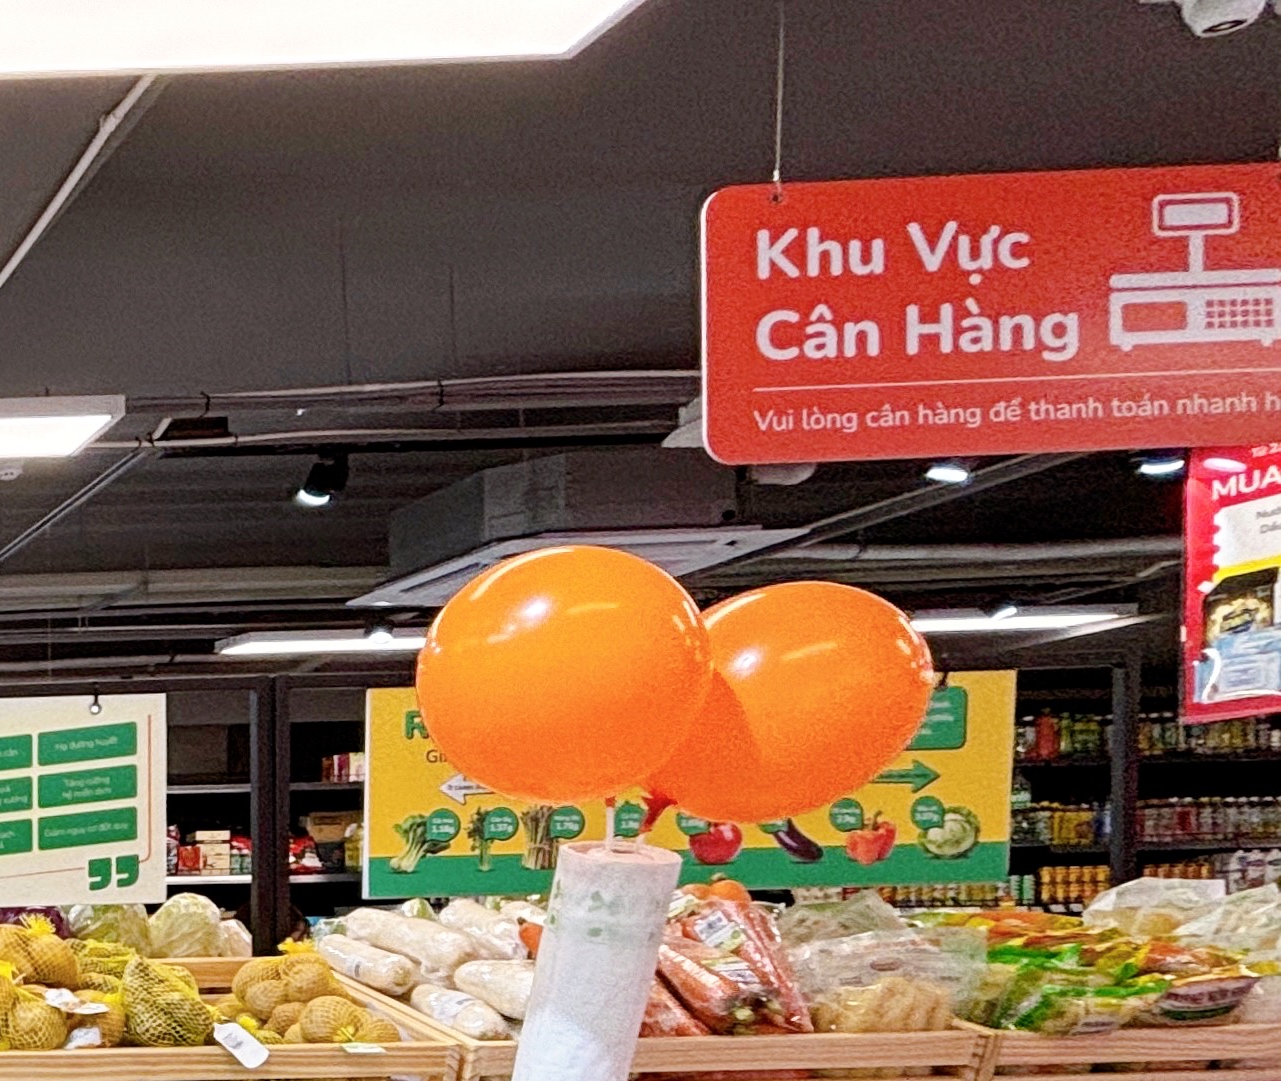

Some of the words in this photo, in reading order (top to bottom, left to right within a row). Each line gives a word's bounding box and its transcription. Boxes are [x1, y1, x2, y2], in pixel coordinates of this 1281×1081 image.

[755, 227, 886, 281] Khu
[906, 220, 1032, 285] Vực
[755, 304, 881, 361] Cân
[905, 297, 1080, 362] Hàng
[753, 409, 794, 432] Vui
[801, 407, 858, 434] lòng
[865, 401, 910, 429] cân
[918, 400, 982, 429] hàng
[989, 398, 1022, 422] để
[1029, 396, 1104, 423] thanh
[1109, 393, 1169, 419] toán
[1174, 390, 1253, 415] nhanh
